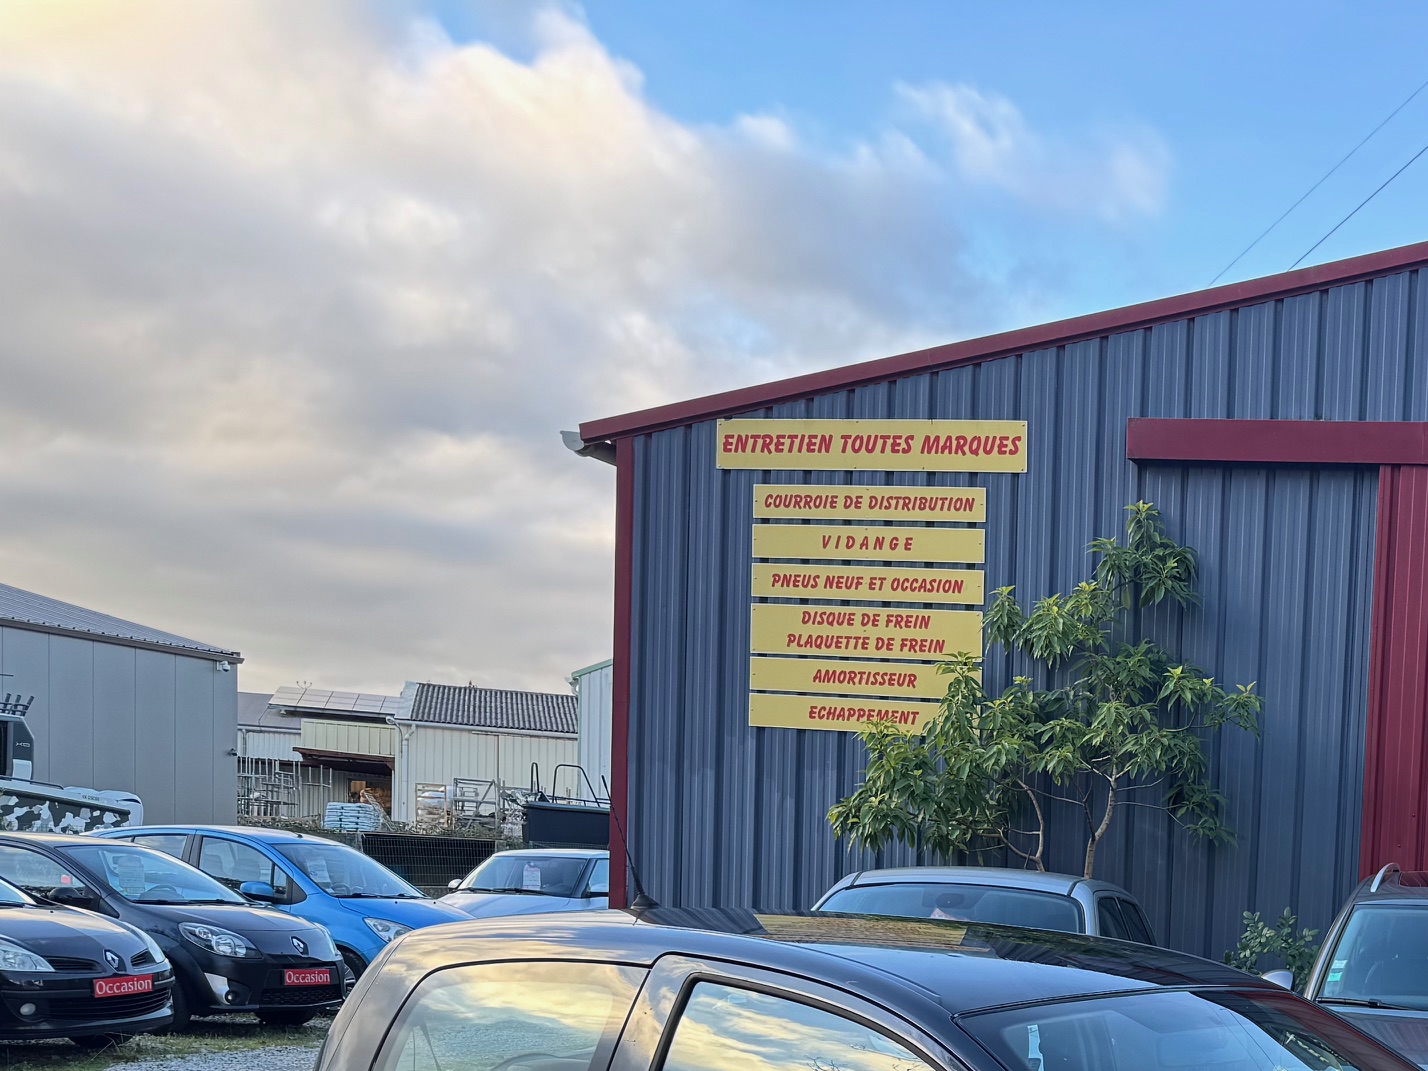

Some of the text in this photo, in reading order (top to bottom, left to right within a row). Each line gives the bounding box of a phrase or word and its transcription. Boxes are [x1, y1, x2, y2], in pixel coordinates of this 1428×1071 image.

[722, 434, 1022, 457] ENTRETIEN TOUTES MARQUES
[764, 494, 975, 512] COURROIE DE DISTRIBUTION
[822, 535, 913, 551] VIDANGE
[771, 573, 964, 594] PNEUS NEUF ET OCCASION
[801, 611, 931, 629] DISQUE DE FREIN
[786, 633, 945, 654] PLAQUETTE DE FREIN
[812, 669, 917, 688] AMORTISSEUR
[808, 705, 919, 725] ECHAPPEMENT
[285, 969, 330, 983] Occasion
[95, 978, 152, 995] Occasion
